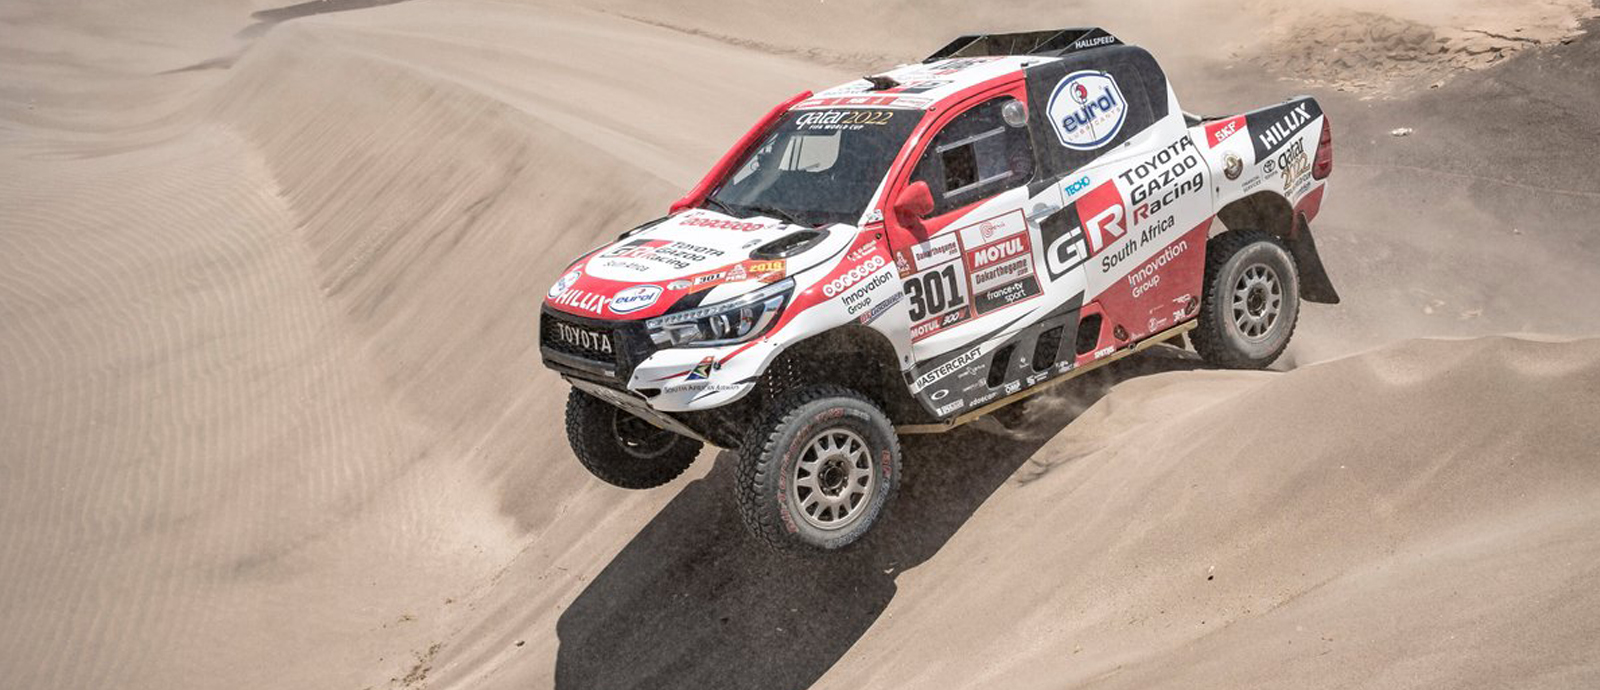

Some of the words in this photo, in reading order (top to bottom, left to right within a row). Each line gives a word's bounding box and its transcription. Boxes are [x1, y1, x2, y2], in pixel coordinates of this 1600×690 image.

[1075, 36, 1115, 49] HALLSPEED
[796, 109, 850, 130] qatar
[842, 111, 893, 126] 2022
[1062, 86, 1116, 132] eurol
[1214, 121, 1236, 142] SKF
[1259, 102, 1311, 150] HILUX
[1118, 135, 1194, 185] TOYOTA
[1064, 176, 1091, 197] TECHO
[1130, 155, 1198, 206] GAZOO
[1134, 172, 1204, 226] Racing
[670, 240, 724, 257] TOYOTA
[974, 238, 1024, 267] MOTUL
[1047, 203, 1125, 275] GR
[1102, 239, 1138, 273] South
[1140, 215, 1175, 247] Africa
[976, 259, 1027, 284] Dakarthegame
[1128, 240, 1188, 287] Innovation
[698, 273, 722, 283] 301
[841, 271, 893, 307] Innovation
[1132, 275, 1161, 298] Group
[615, 292, 656, 304] eurol
[848, 297, 872, 315] Group
[903, 264, 963, 322] 301
[1005, 290, 1027, 303] sport
[557, 322, 612, 353] TOYOTA
[911, 320, 940, 339] MOTUL
